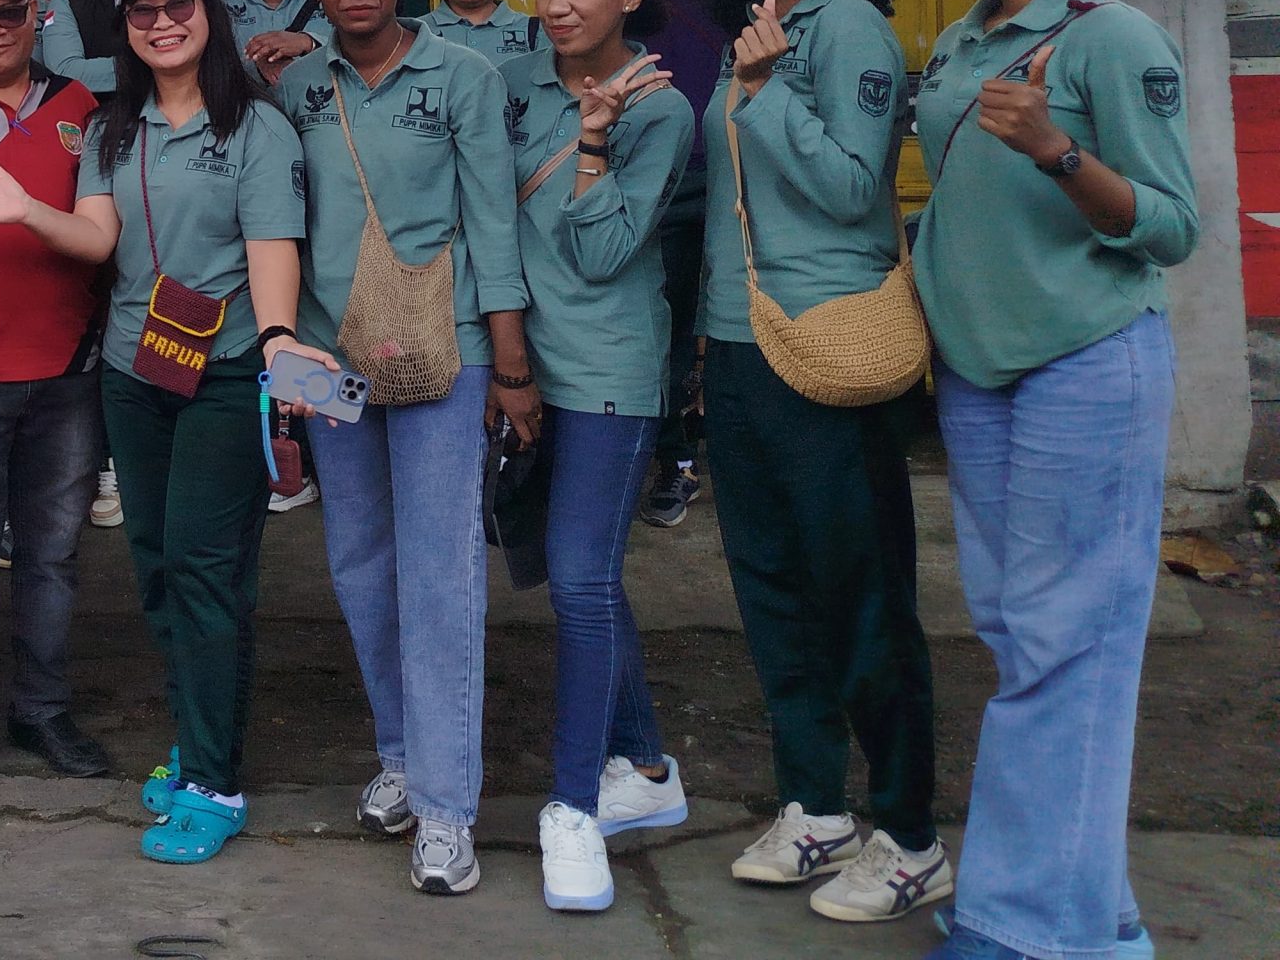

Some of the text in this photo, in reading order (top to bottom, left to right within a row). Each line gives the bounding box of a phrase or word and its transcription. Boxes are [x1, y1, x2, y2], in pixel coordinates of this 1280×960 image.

[399, 118, 442, 133] PUPR MIMIKA
[191, 161, 207, 170] PUPR
[143, 330, 207, 371] PAPUA
